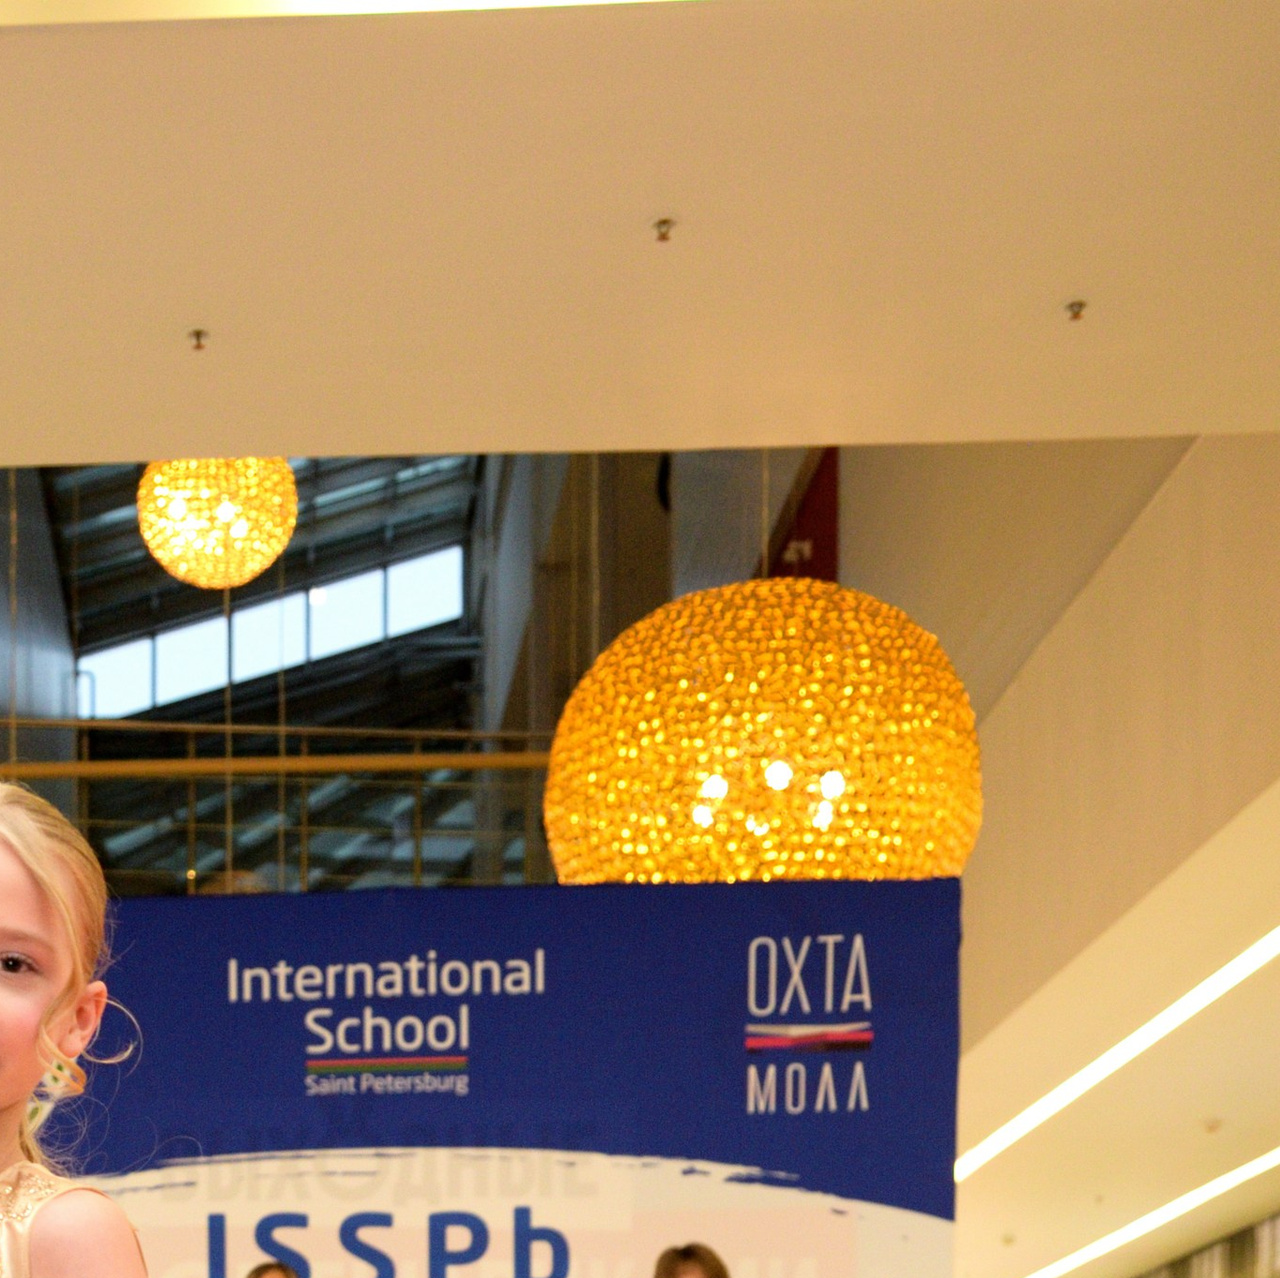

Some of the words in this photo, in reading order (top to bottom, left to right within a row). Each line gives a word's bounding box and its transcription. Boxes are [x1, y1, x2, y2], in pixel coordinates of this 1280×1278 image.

[227, 947, 546, 1003] International
[746, 932, 872, 1018] ОХТА
[304, 1003, 469, 1054] School
[304, 1075, 355, 1097] Saint
[360, 1071, 469, 1097] Petersburg
[746, 1060, 869, 1115] МОЛЛ
